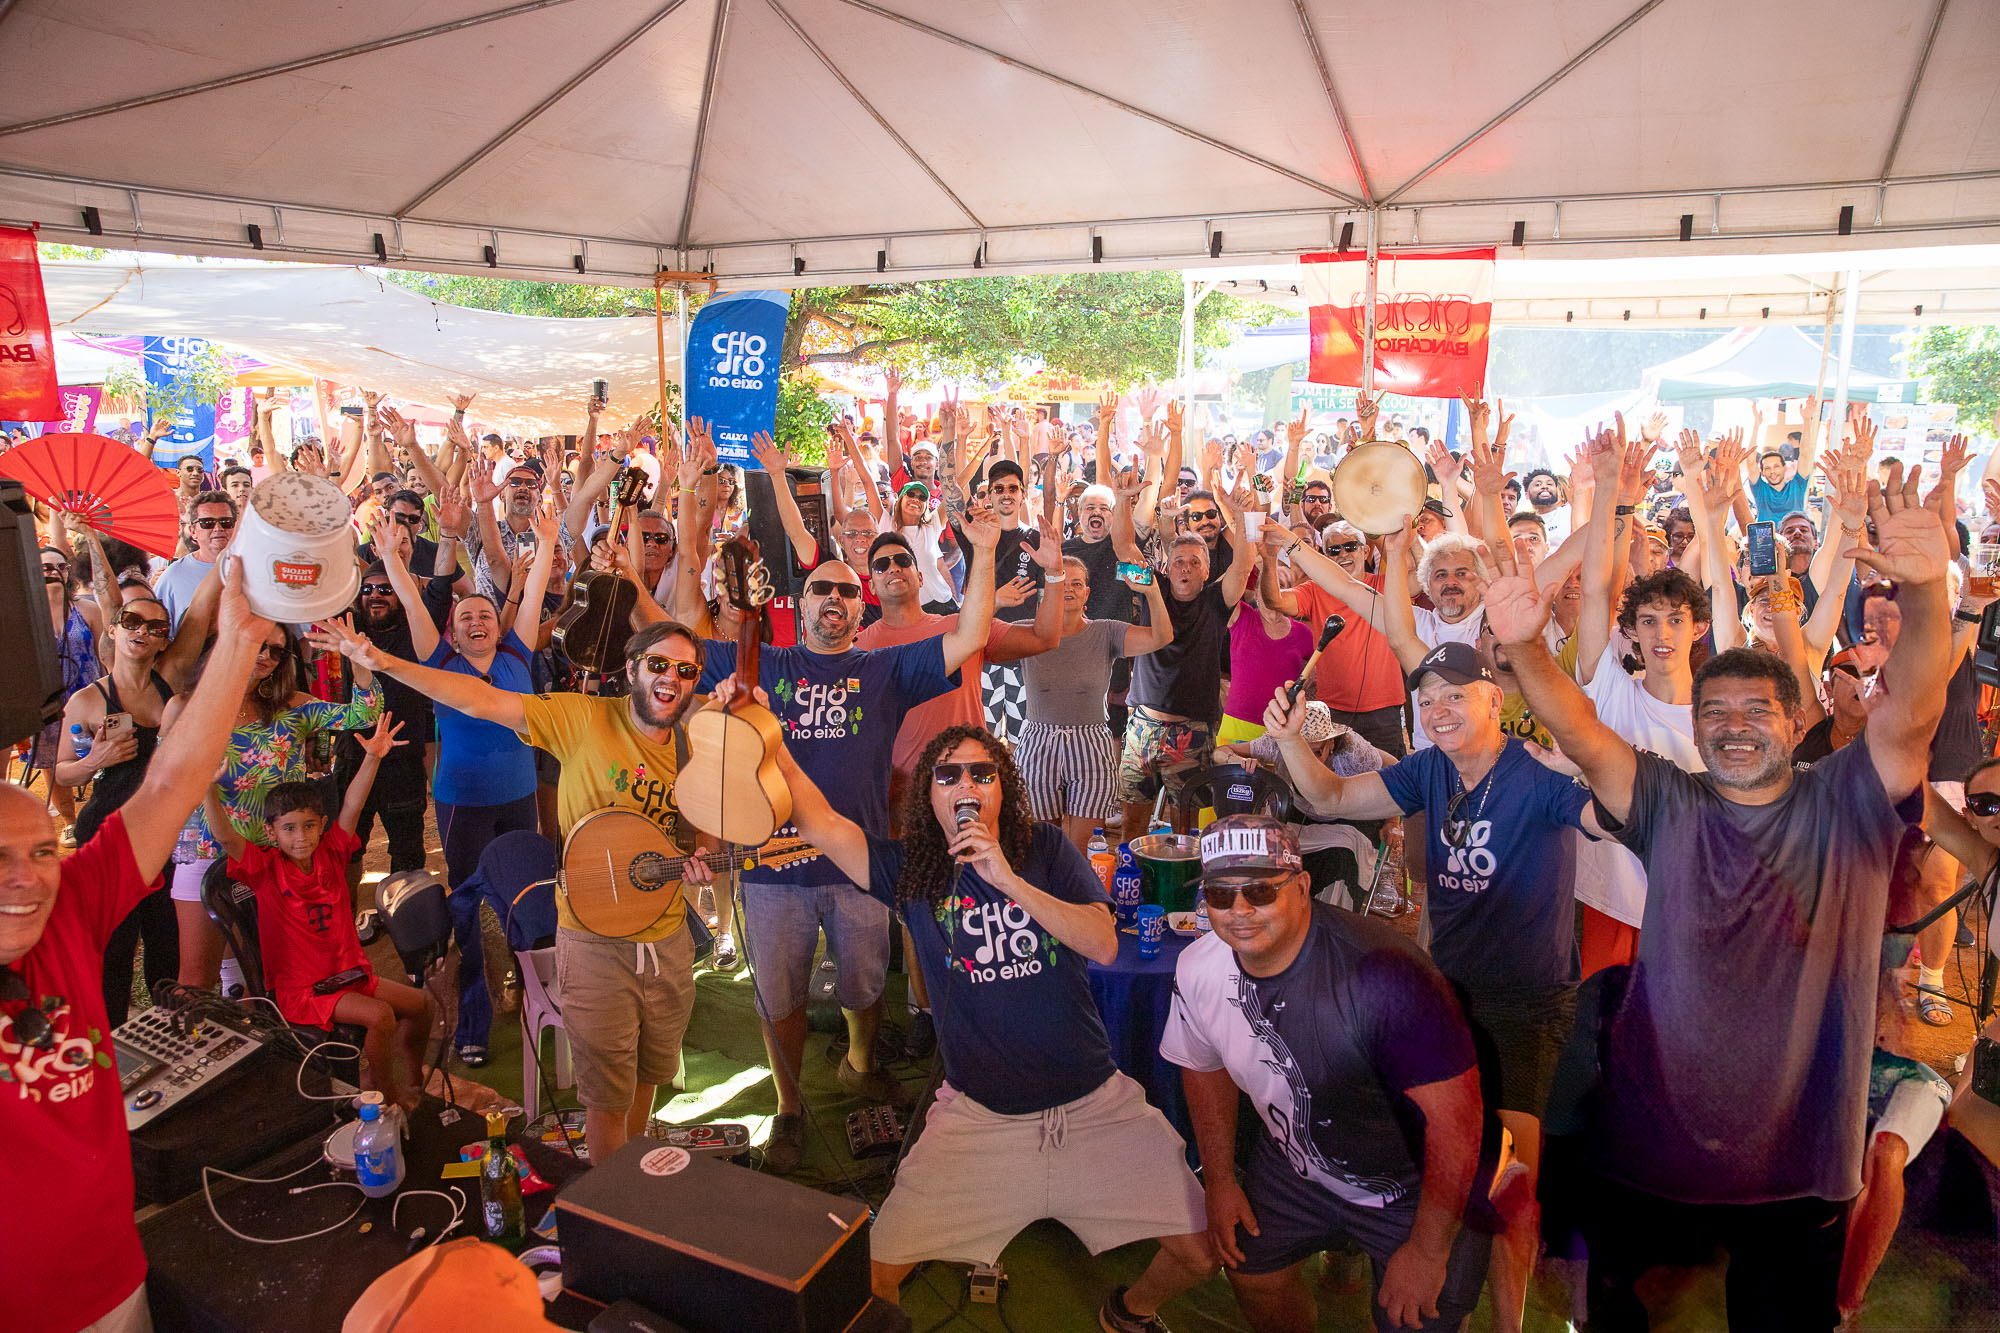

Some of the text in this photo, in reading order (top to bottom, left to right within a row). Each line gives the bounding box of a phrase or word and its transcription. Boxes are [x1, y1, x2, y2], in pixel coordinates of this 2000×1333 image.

[709, 375, 763, 390] no eixo
[1317, 397, 1337, 409] TIA
[720, 432, 749, 442] CAIXA
[716, 446, 750, 459] BRASIL
[281, 566, 314, 575] ARTOIS
[281, 573, 313, 581] STELLA
[791, 724, 847, 740] no eixo
[1438, 873, 1460, 890] no
[970, 958, 1043, 984] no eixo
